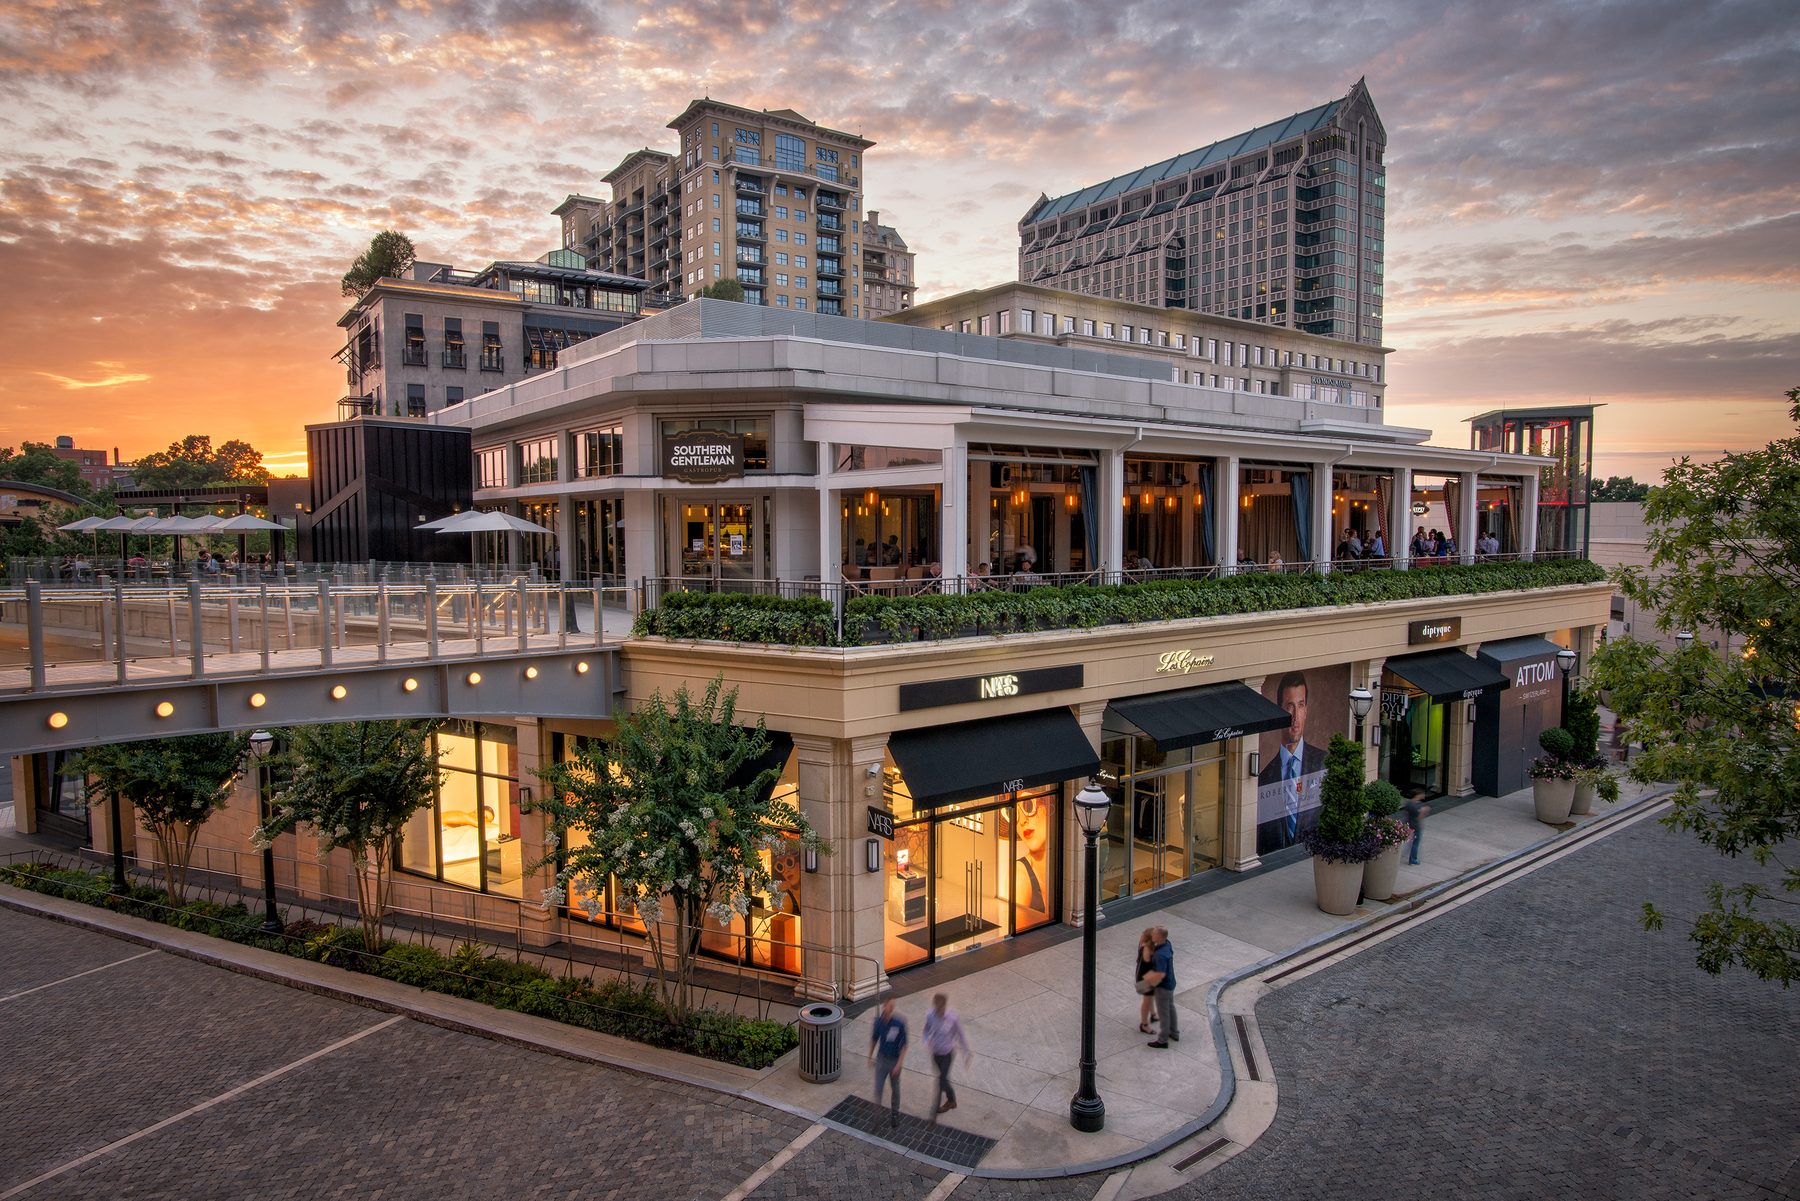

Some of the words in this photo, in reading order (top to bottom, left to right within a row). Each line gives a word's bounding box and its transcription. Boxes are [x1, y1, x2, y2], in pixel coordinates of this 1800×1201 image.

[673, 445, 731, 455] SOUTHERN
[670, 455, 735, 466] GENTLEMAN
[1422, 625, 1452, 638] diptyque
[1156, 651, 1178, 673] Les
[1176, 649, 1215, 674] Copains
[1515, 660, 1555, 688] ATTOM
[981, 674, 1019, 699] NARS
[1463, 688, 1483, 699] diptyque
[1522, 688, 1547, 700] SWITZERLAND
[1003, 778, 1024, 794] NARS
[1260, 784, 1293, 800] ROBERT
[868, 810, 893, 836] NARS
